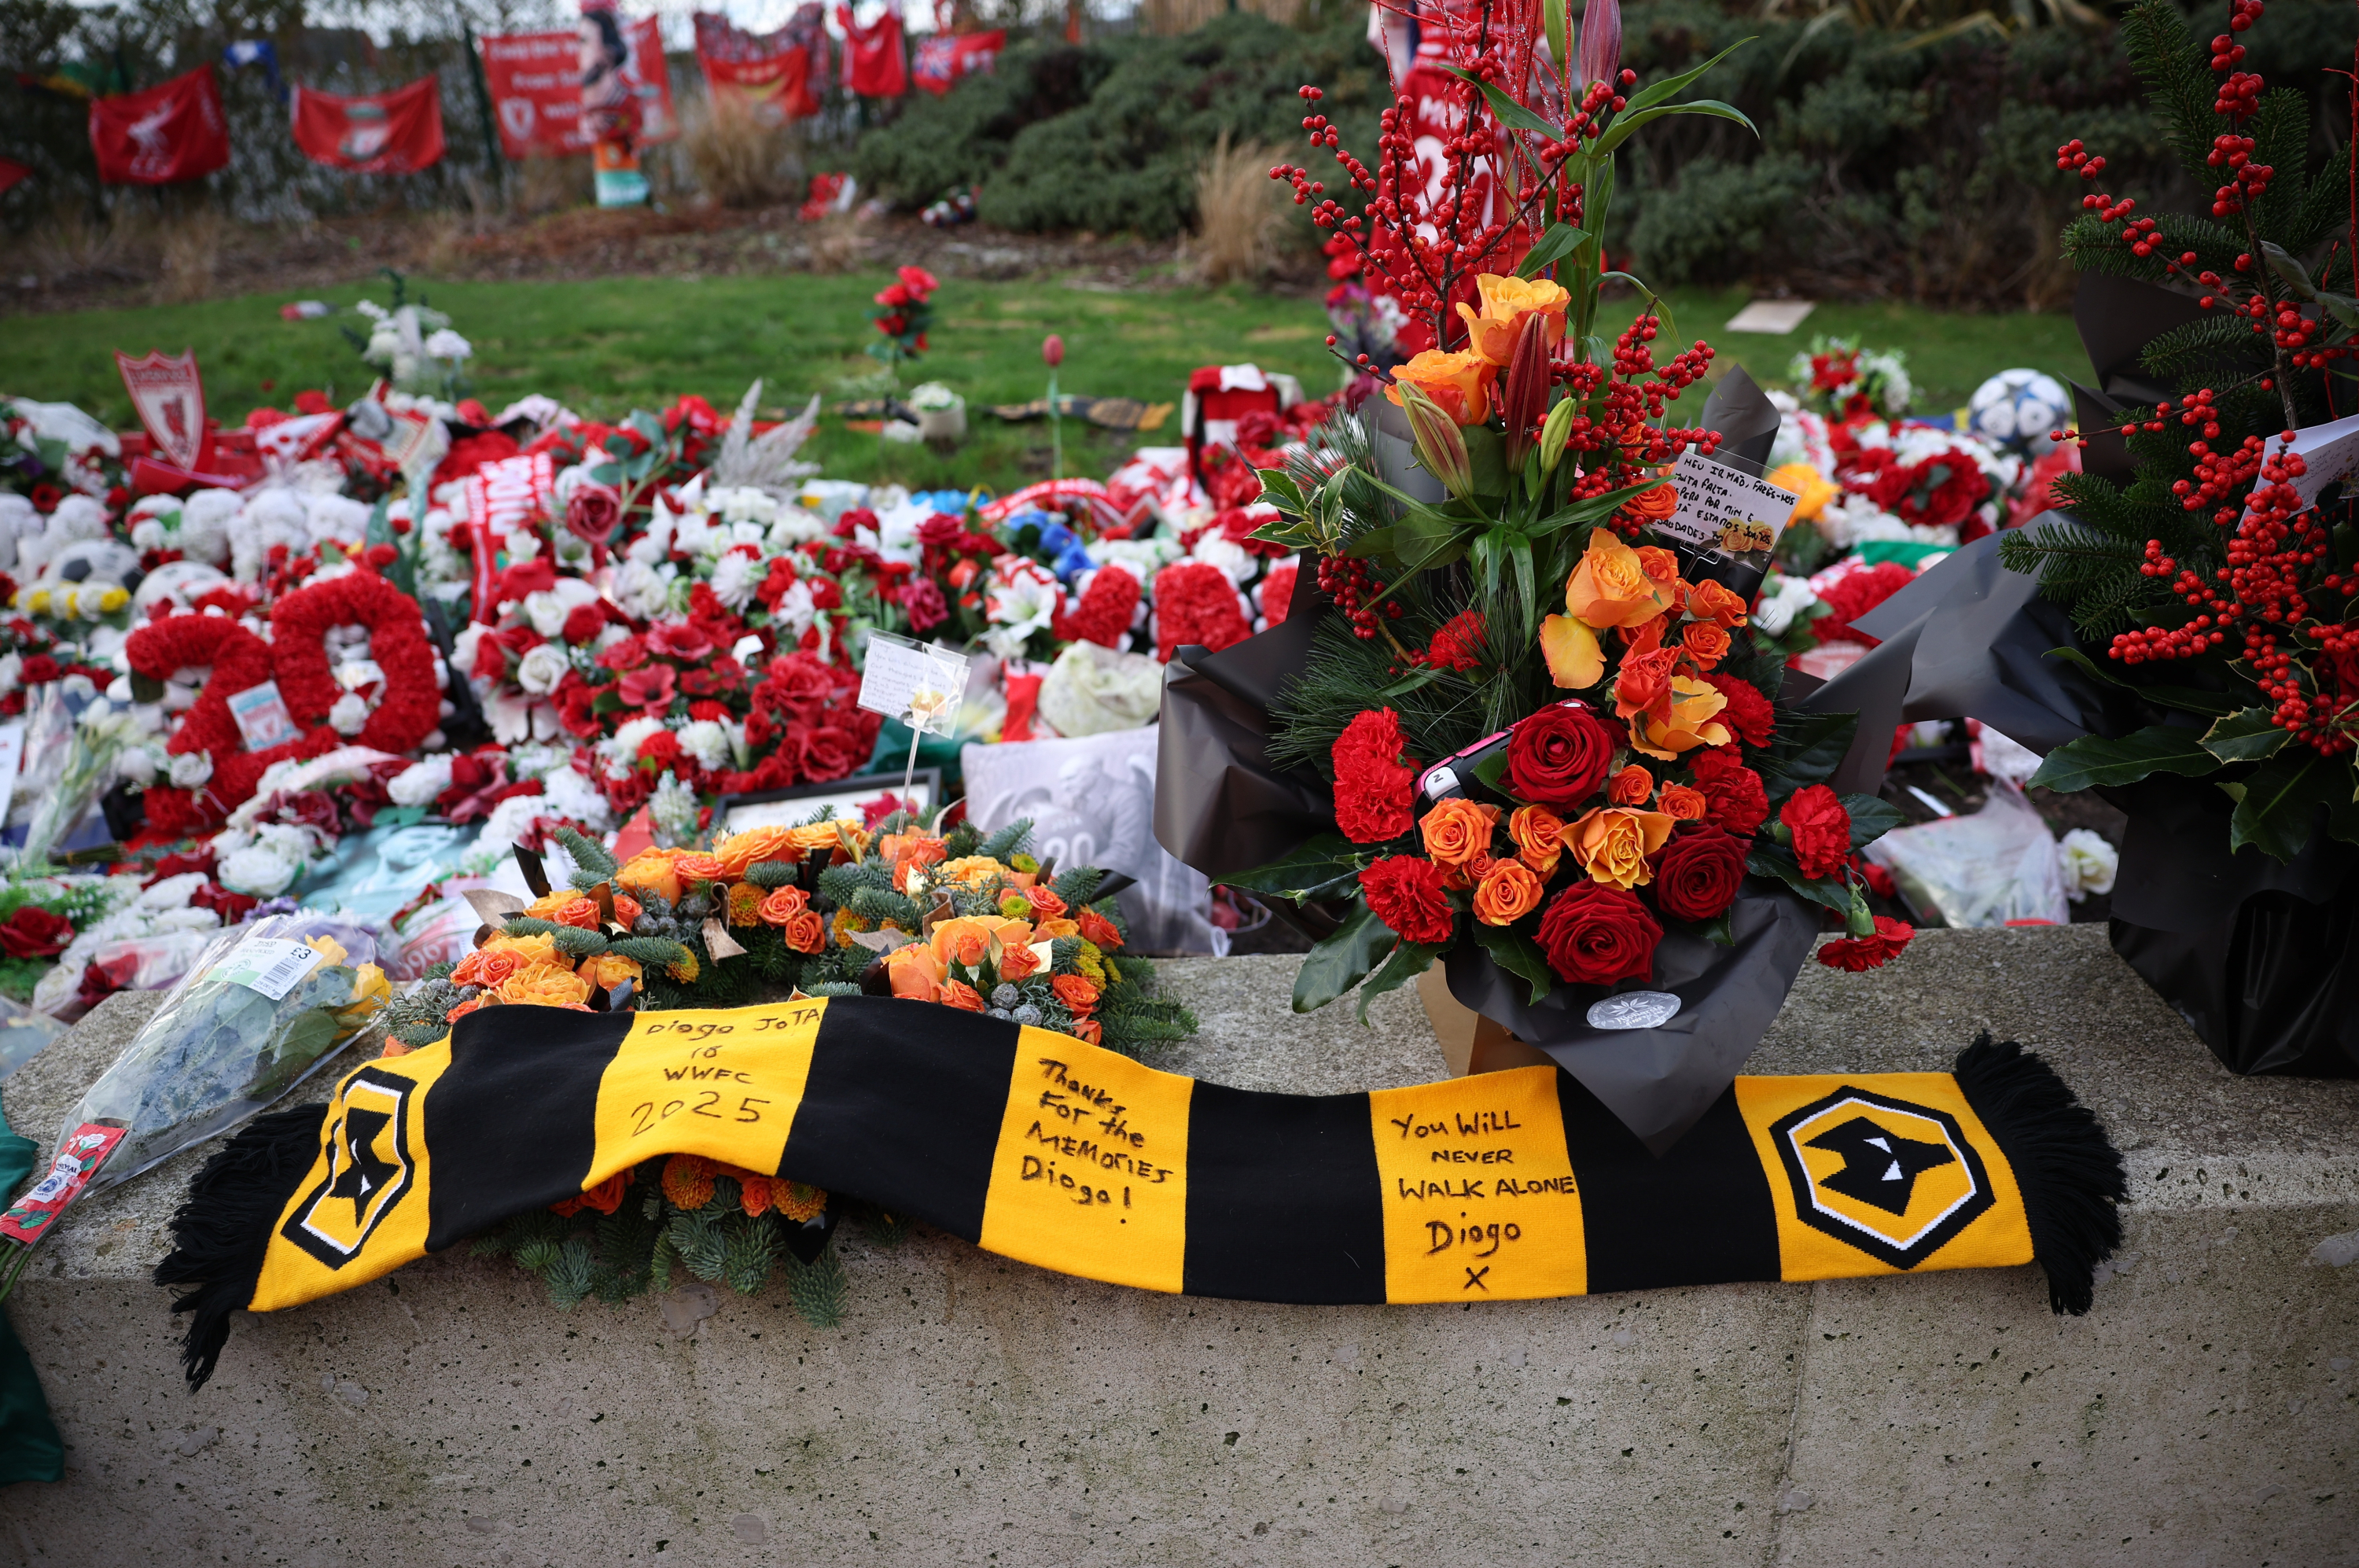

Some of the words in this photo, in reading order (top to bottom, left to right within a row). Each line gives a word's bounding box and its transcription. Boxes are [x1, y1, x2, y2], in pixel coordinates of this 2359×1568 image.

[1684, 458, 1705, 471] MEU
[1673, 486, 1699, 502] SPERA
[1705, 495, 1720, 510] POR
[1696, 510, 1739, 532] ESTAMOS
[289, 947, 311, 959] £3
[646, 1020, 734, 1042] Diogo
[663, 1065, 754, 1084] WWFC
[1038, 1058, 1127, 1117] Thanks
[630, 1091, 771, 1138] 2025
[1390, 1113, 1449, 1140] You
[1099, 1117, 1145, 1149] the
[1431, 1148, 1515, 1165] NEVER
[1398, 1177, 1486, 1202] WALK
[1495, 1176, 1576, 1198] ALONE
[1423, 1211, 1522, 1260] Diogo
